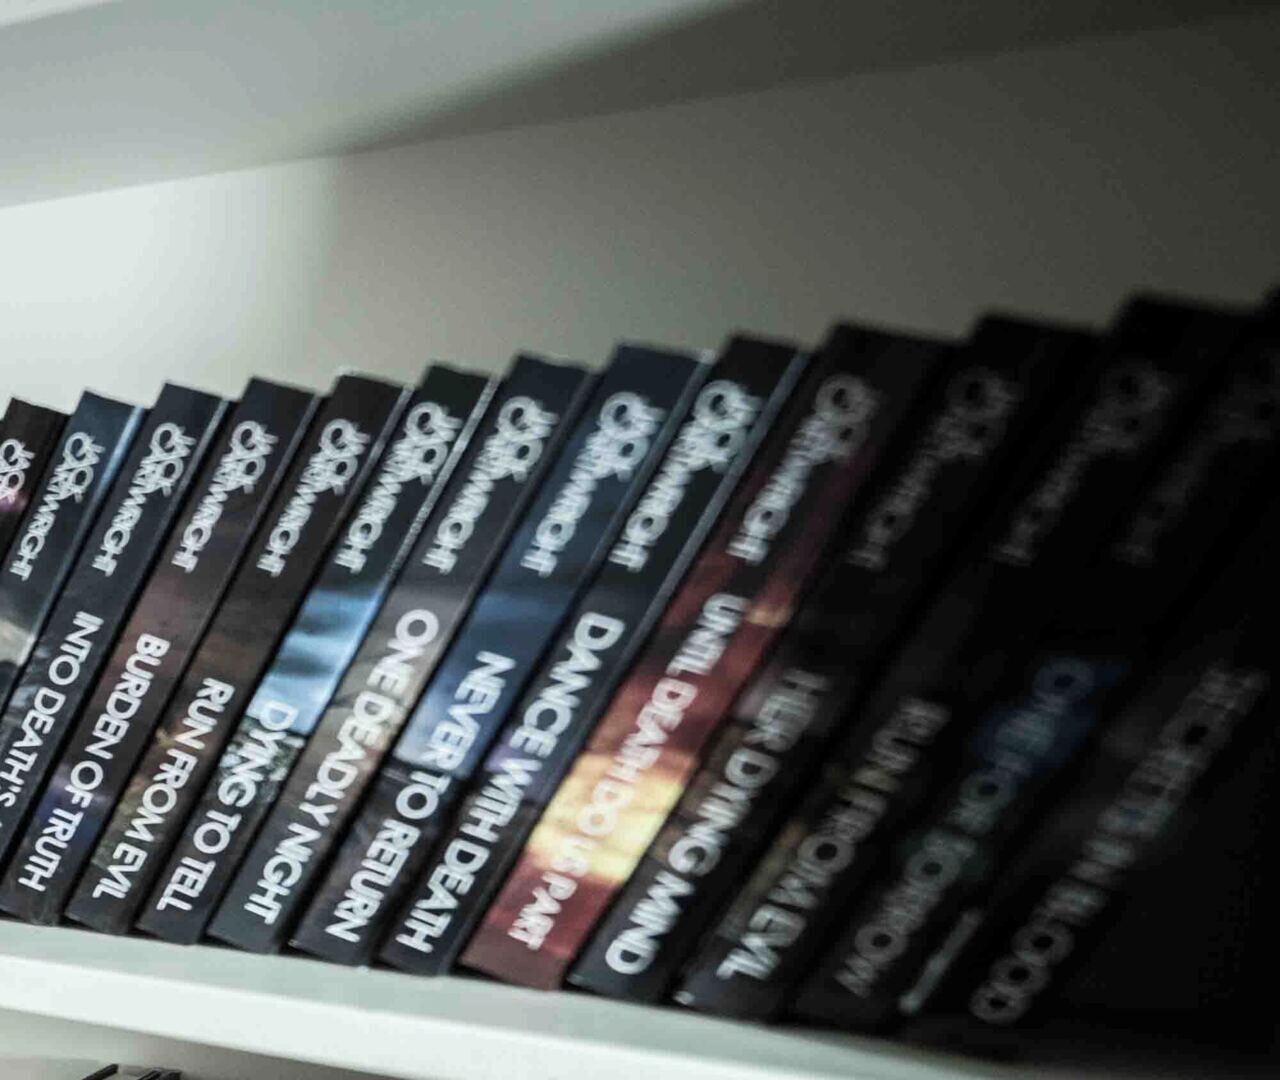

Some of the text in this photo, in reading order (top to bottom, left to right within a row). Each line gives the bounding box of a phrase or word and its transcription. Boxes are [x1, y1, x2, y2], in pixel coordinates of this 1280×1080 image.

[49, 611, 105, 687] INTO
[608, 678, 700, 783] DEATH
[664, 592, 749, 678] UNTIL
[18, 633, 171, 892] BURDEN OF TRUTH
[92, 677, 236, 901] RUN FROM EVIL
[156, 699, 305, 912] DYING TO TELL
[244, 608, 440, 925] ONE DEADLY NIGHT
[326, 649, 517, 943] NEVER TO RETURN
[396, 611, 626, 953] DANCE WITH DEATH
[507, 870, 579, 952] PART
[605, 870, 696, 975] MIND
